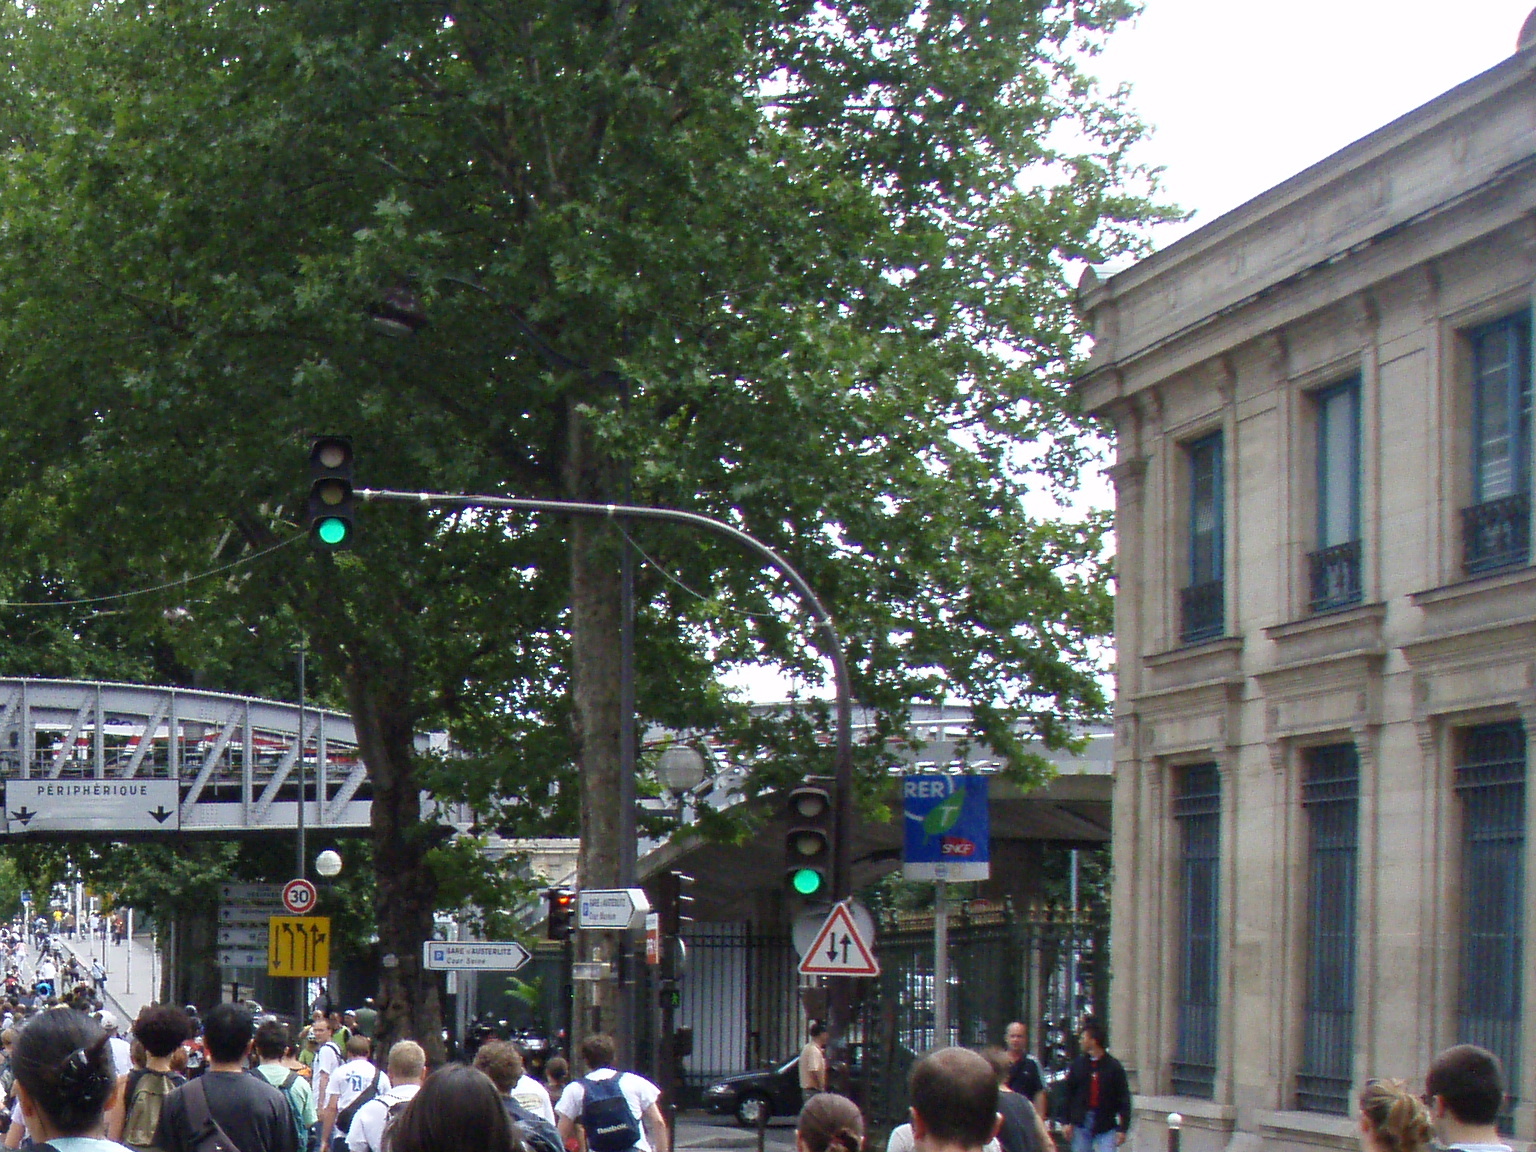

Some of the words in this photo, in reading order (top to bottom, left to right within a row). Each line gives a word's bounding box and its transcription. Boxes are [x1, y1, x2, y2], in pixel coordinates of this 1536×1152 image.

[37, 782, 148, 796] PÉRIPHÉRIQUE
[904, 781, 945, 798] RER
[942, 843, 972, 854] SNCF
[290, 890, 309, 903] 30
